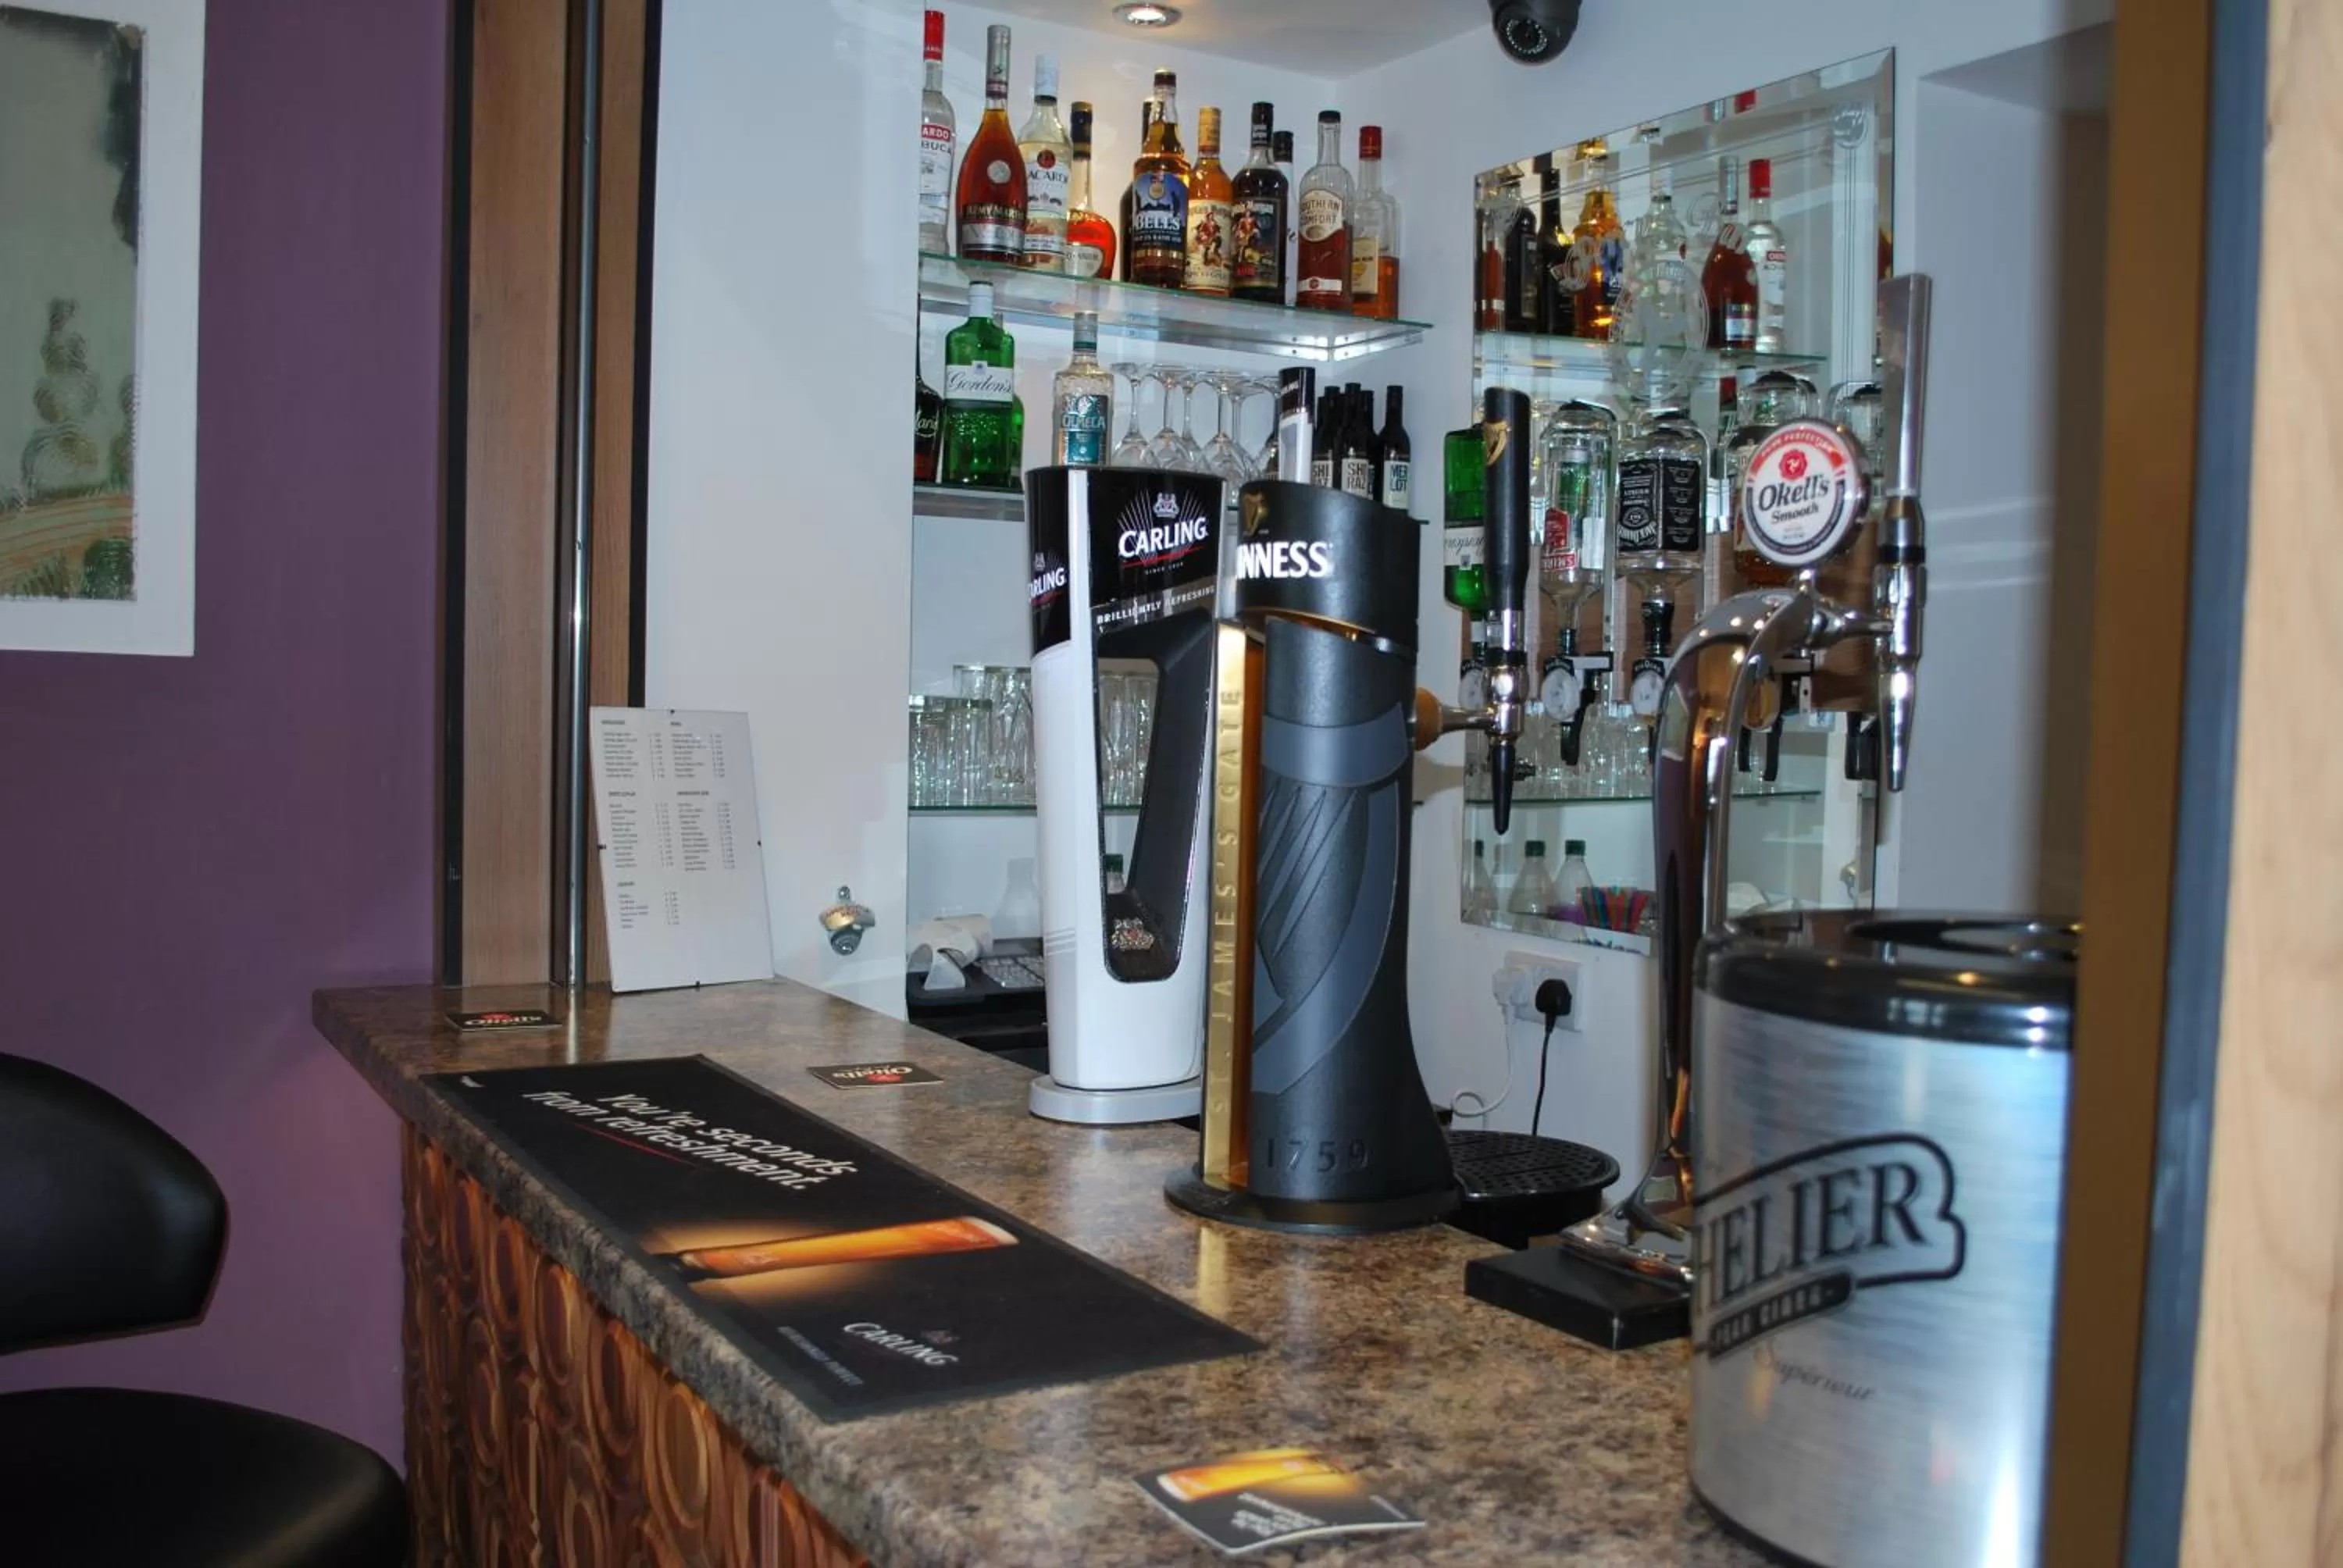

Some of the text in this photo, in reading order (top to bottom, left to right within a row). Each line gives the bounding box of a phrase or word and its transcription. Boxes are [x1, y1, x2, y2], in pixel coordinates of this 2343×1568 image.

[947, 370, 1013, 394] Gordon's
[1758, 472, 1831, 511] Okell's
[1771, 504, 1820, 524] Smooth
[1118, 516, 1209, 558] CARLING
[1218, 690, 1242, 802] GATE
[1211, 829, 1238, 1023] JAMES'S
[521, 1089, 611, 1117] from
[597, 1092, 859, 1177] You're seconds
[1268, 1138, 1368, 1173] 1759
[842, 1321, 960, 1367] CARLING
